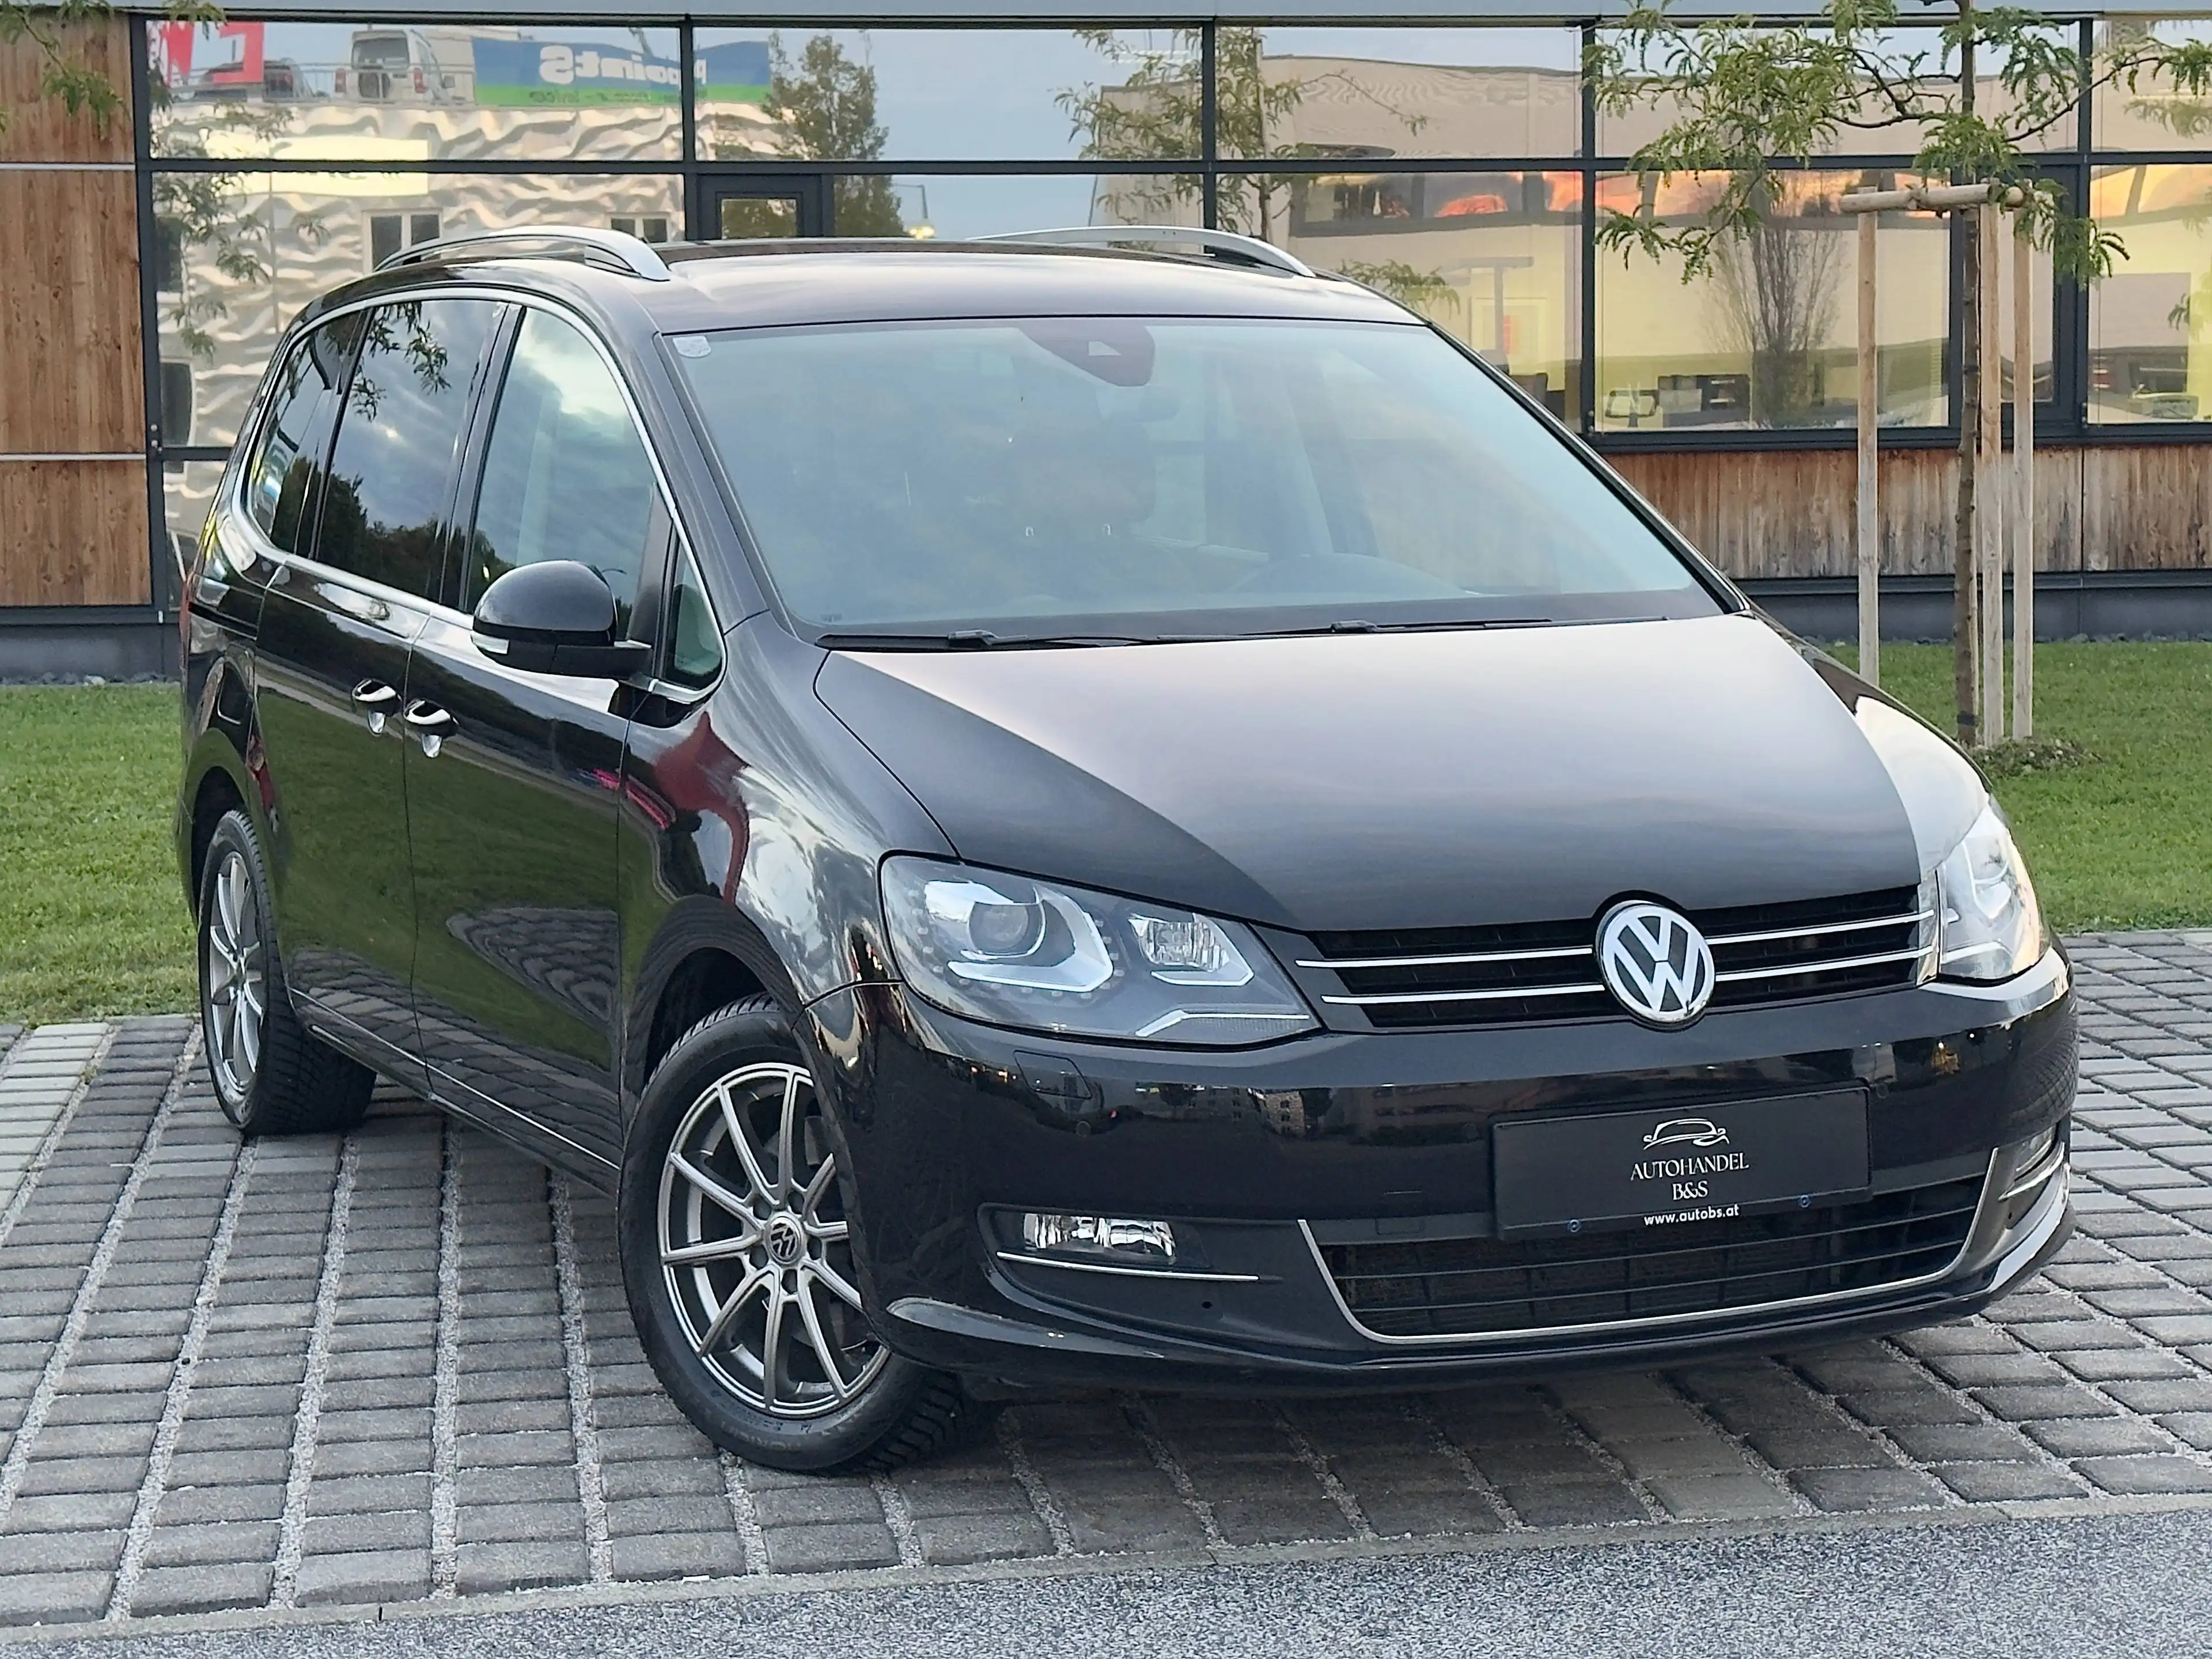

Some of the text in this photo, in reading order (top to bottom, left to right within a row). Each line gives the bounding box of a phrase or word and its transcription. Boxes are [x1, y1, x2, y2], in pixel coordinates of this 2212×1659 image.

[1601, 906, 1712, 1020] VW
[1630, 1152, 1749, 1181] AUTOHANDEL
[1672, 1180, 1708, 1200] B&S
[1643, 1203, 1740, 1226] www.autobs.at
